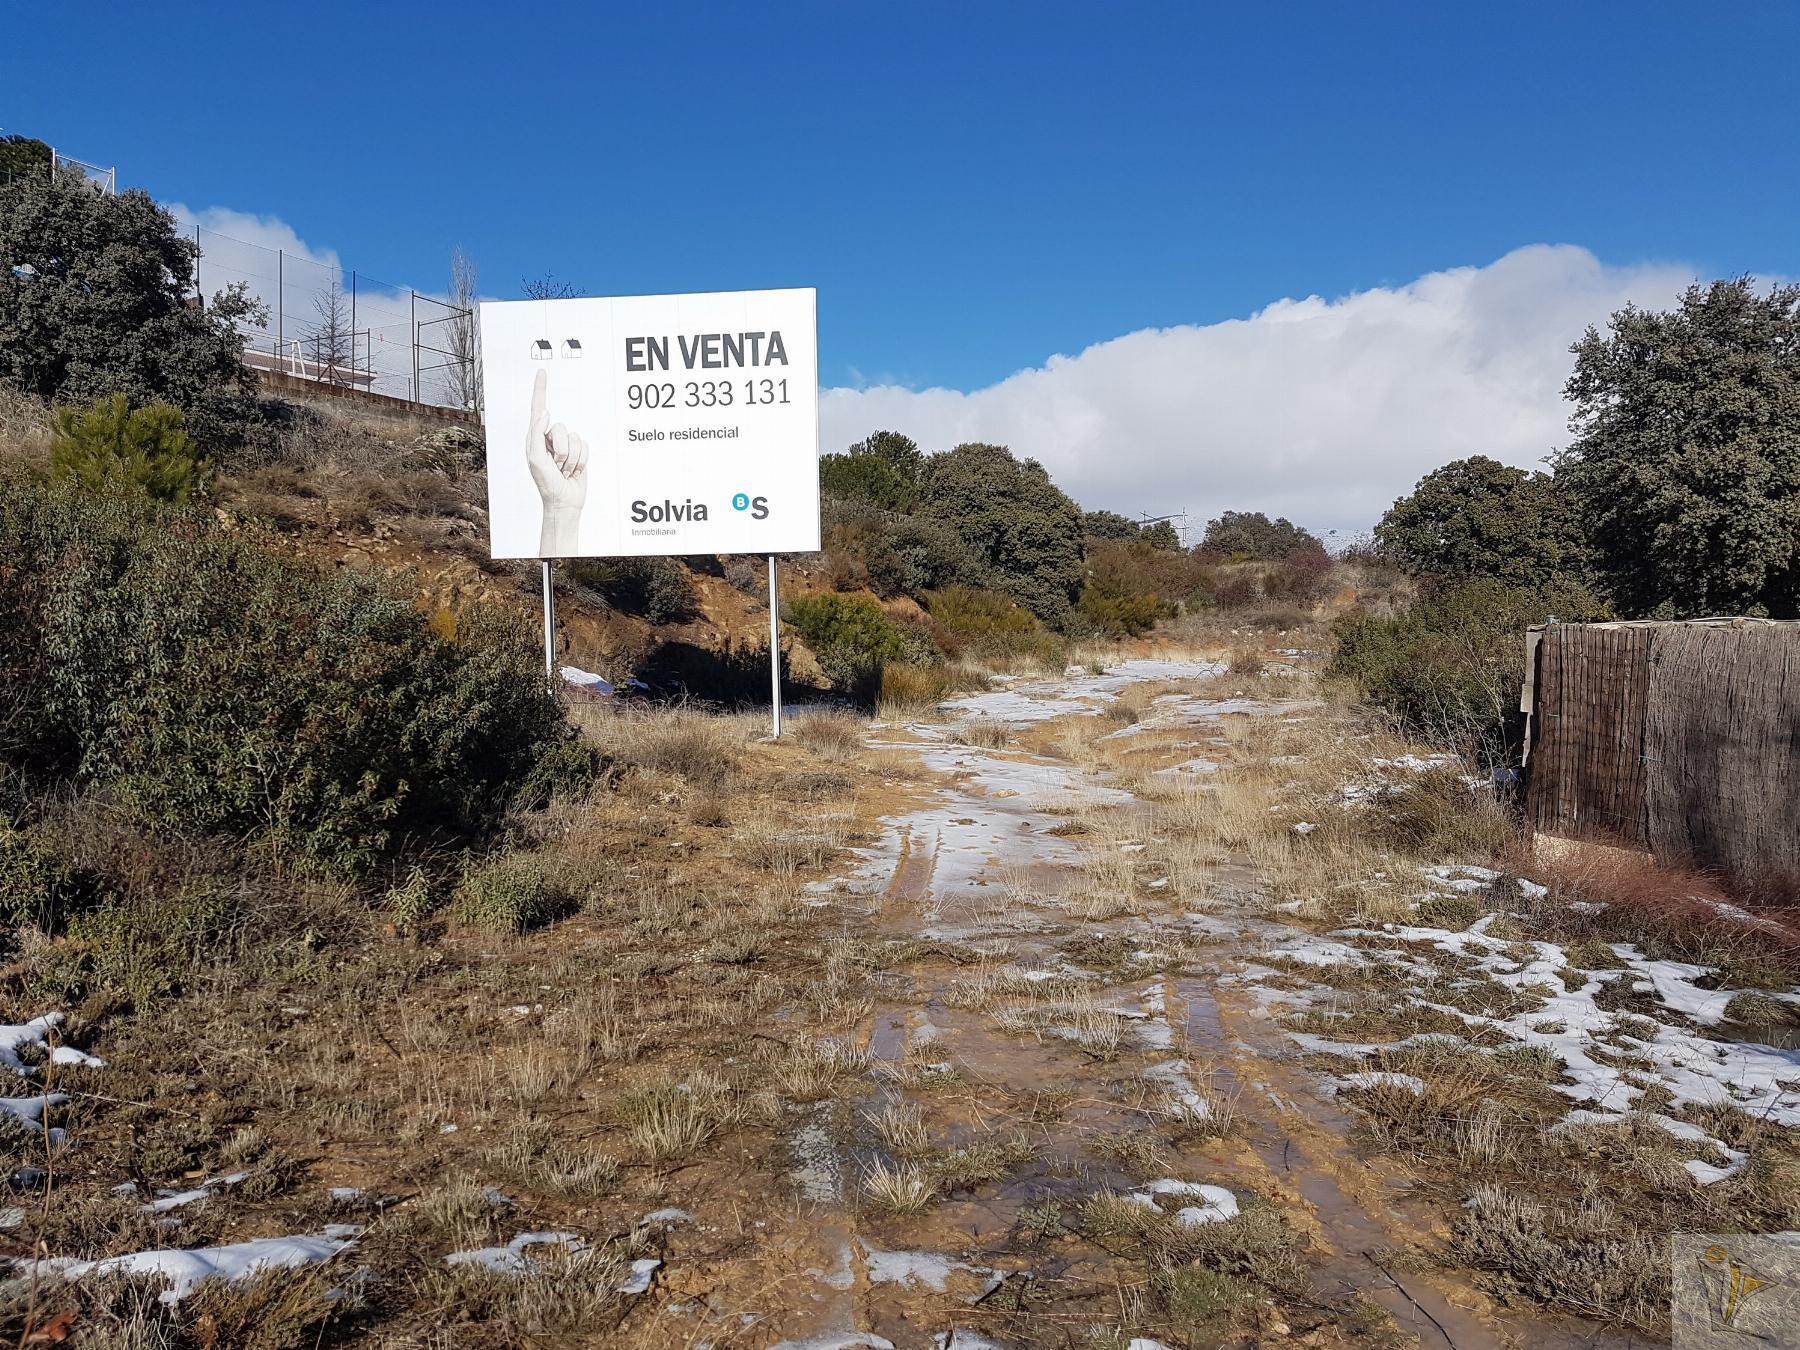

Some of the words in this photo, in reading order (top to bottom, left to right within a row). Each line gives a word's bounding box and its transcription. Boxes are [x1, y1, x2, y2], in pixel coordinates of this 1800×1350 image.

[626, 336, 669, 371] EN
[677, 331, 788, 369] VENTA
[628, 383, 675, 409] 902
[685, 381, 733, 407] 333
[745, 379, 790, 405] 131
[629, 429, 665, 442] Suelo
[670, 426, 739, 440] residencial
[631, 499, 708, 523] Solvia
[631, 527, 677, 537] Inmobiliaria
